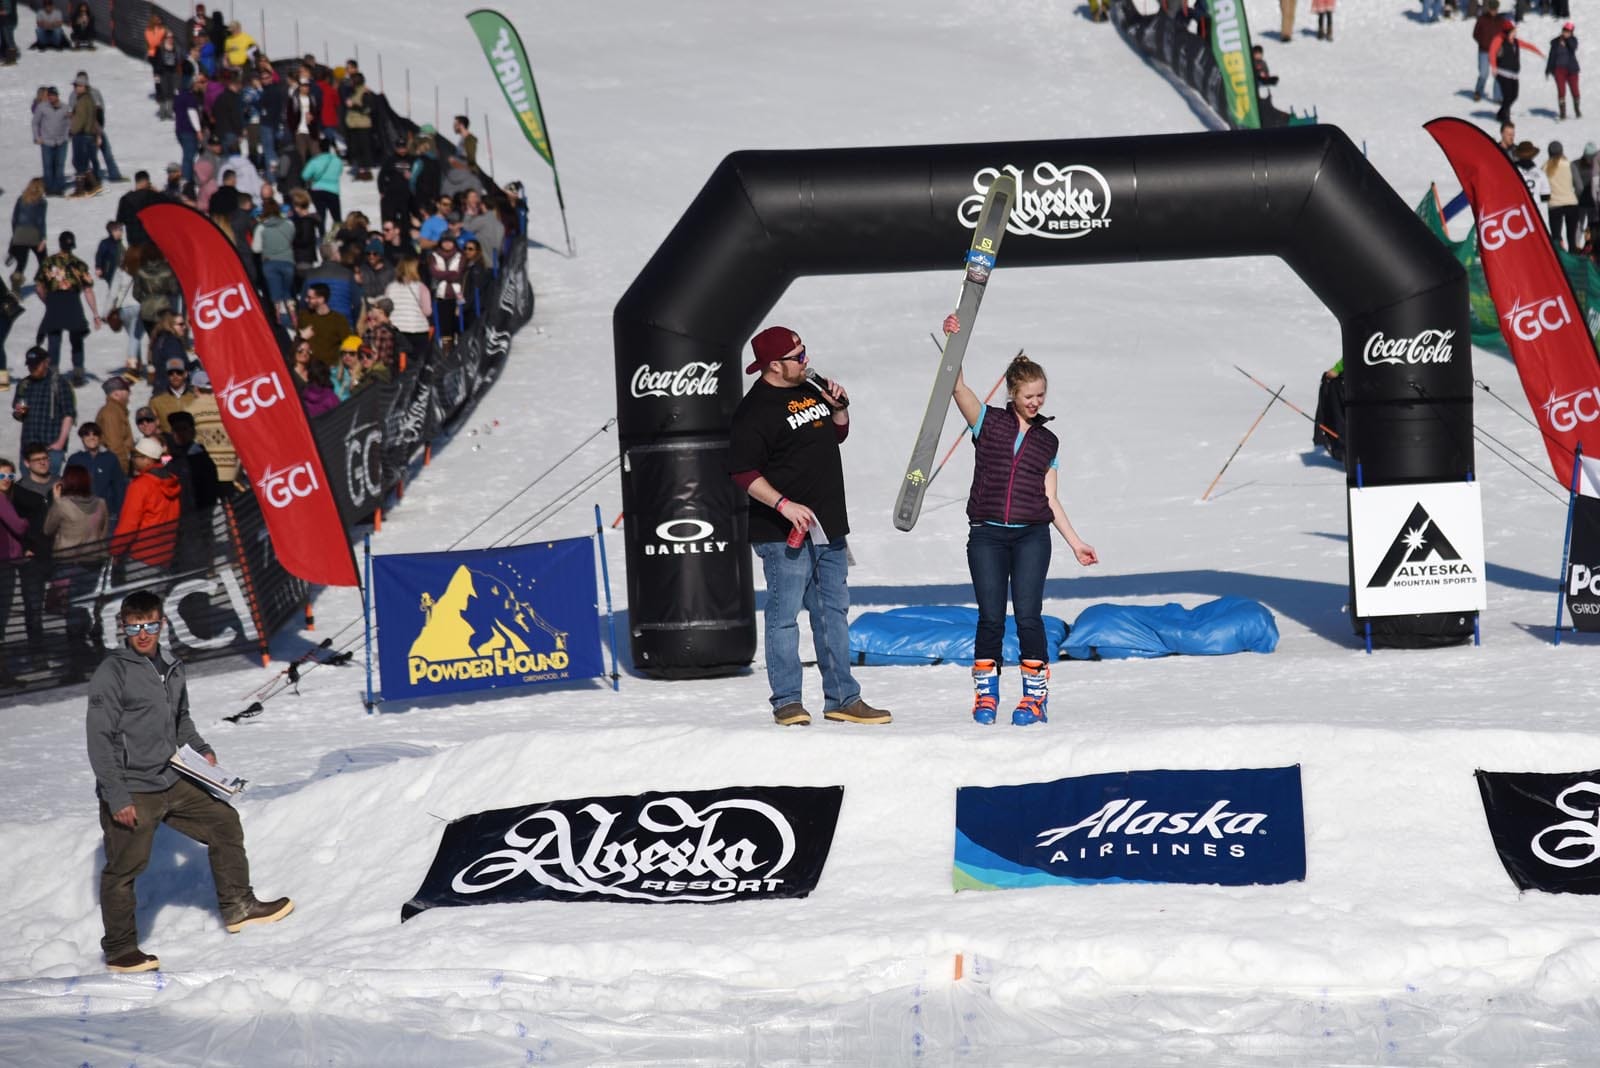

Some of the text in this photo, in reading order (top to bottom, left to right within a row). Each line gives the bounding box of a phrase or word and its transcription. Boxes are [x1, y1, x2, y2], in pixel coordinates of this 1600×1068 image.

[1048, 218, 1112, 230] RESORT
[1479, 204, 1535, 251] GCI
[194, 282, 252, 330] GCI
[1513, 295, 1572, 341] GCI
[1363, 329, 1456, 366] Coca-Cola
[226, 371, 286, 420] GCI
[631, 361, 722, 398] Coca-Cola
[265, 461, 319, 508] GCI
[346, 430, 383, 507] GC
[644, 541, 728, 555] OAKLEY
[1393, 577, 1478, 587] MOUNTAIN SPORTS
[1397, 563, 1473, 577] ALYESKA
[1036, 797, 1268, 847] Alaska
[452, 797, 795, 901] Alyeska
[1050, 843, 1246, 864] AIRLINES
[640, 878, 784, 892] RESORT
